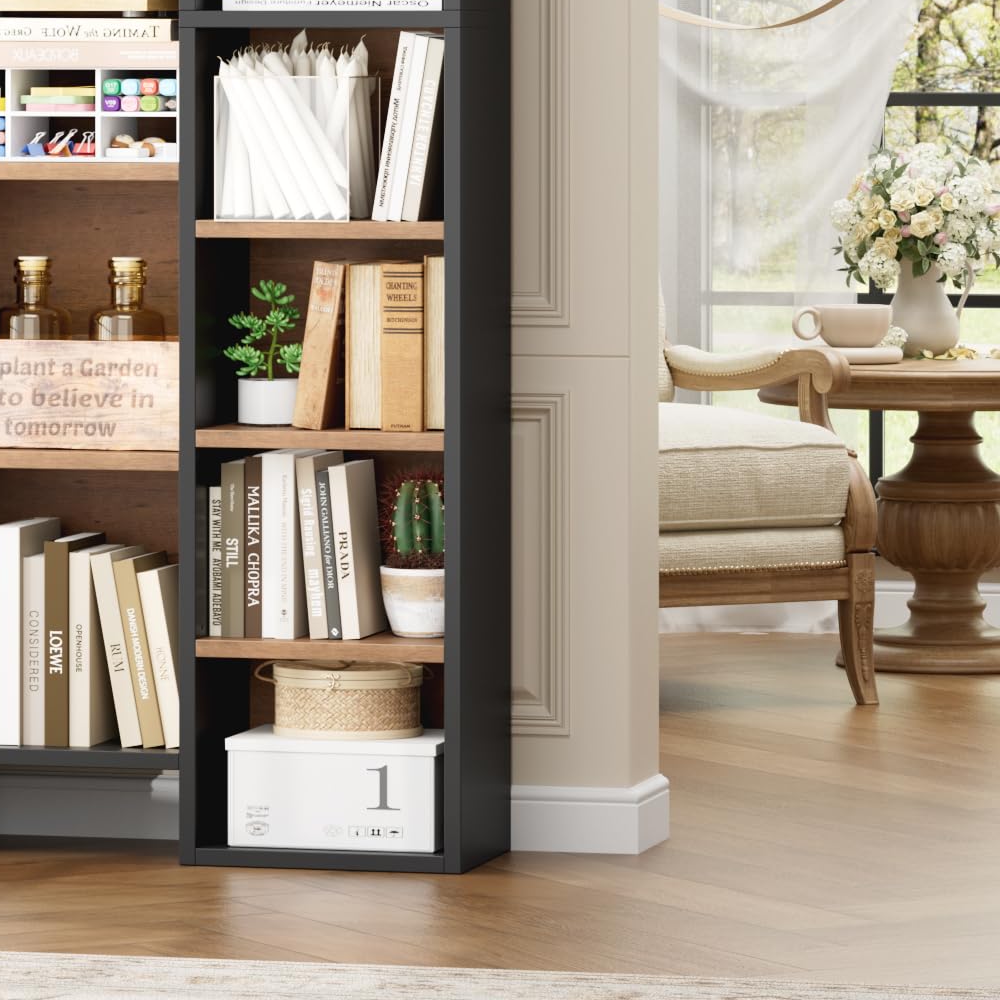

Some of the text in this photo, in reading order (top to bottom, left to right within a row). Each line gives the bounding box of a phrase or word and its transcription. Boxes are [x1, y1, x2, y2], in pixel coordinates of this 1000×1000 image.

[389, 0, 428, 8] Oscar
[386, 281, 418, 291] CHANTING
[386, 292, 417, 302] WHEELS
[0, 358, 55, 379] plant
[62, 364, 73, 375] a
[80, 359, 159, 378] Garden
[32, 388, 123, 408] believe
[131, 389, 154, 408] in
[5, 417, 117, 437] tomorrow
[212, 500, 221, 516] STAY
[212, 519, 221, 539] WITH
[319, 482, 334, 589] JOHN GALLIANO for DIOR
[212, 541, 221, 552] ME
[226, 538, 239, 568] STILL
[247, 486, 260, 607] MALLIKA CHOPRA
[338, 532, 350, 580] PRADA
[307, 568, 323, 617] mayhem
[29, 610, 39, 692] CONSIDERED
[49, 630, 63, 674] LOEWE
[126, 608, 150, 700] DANISH MODERN DESIGN
[366, 765, 401, 810] 1
